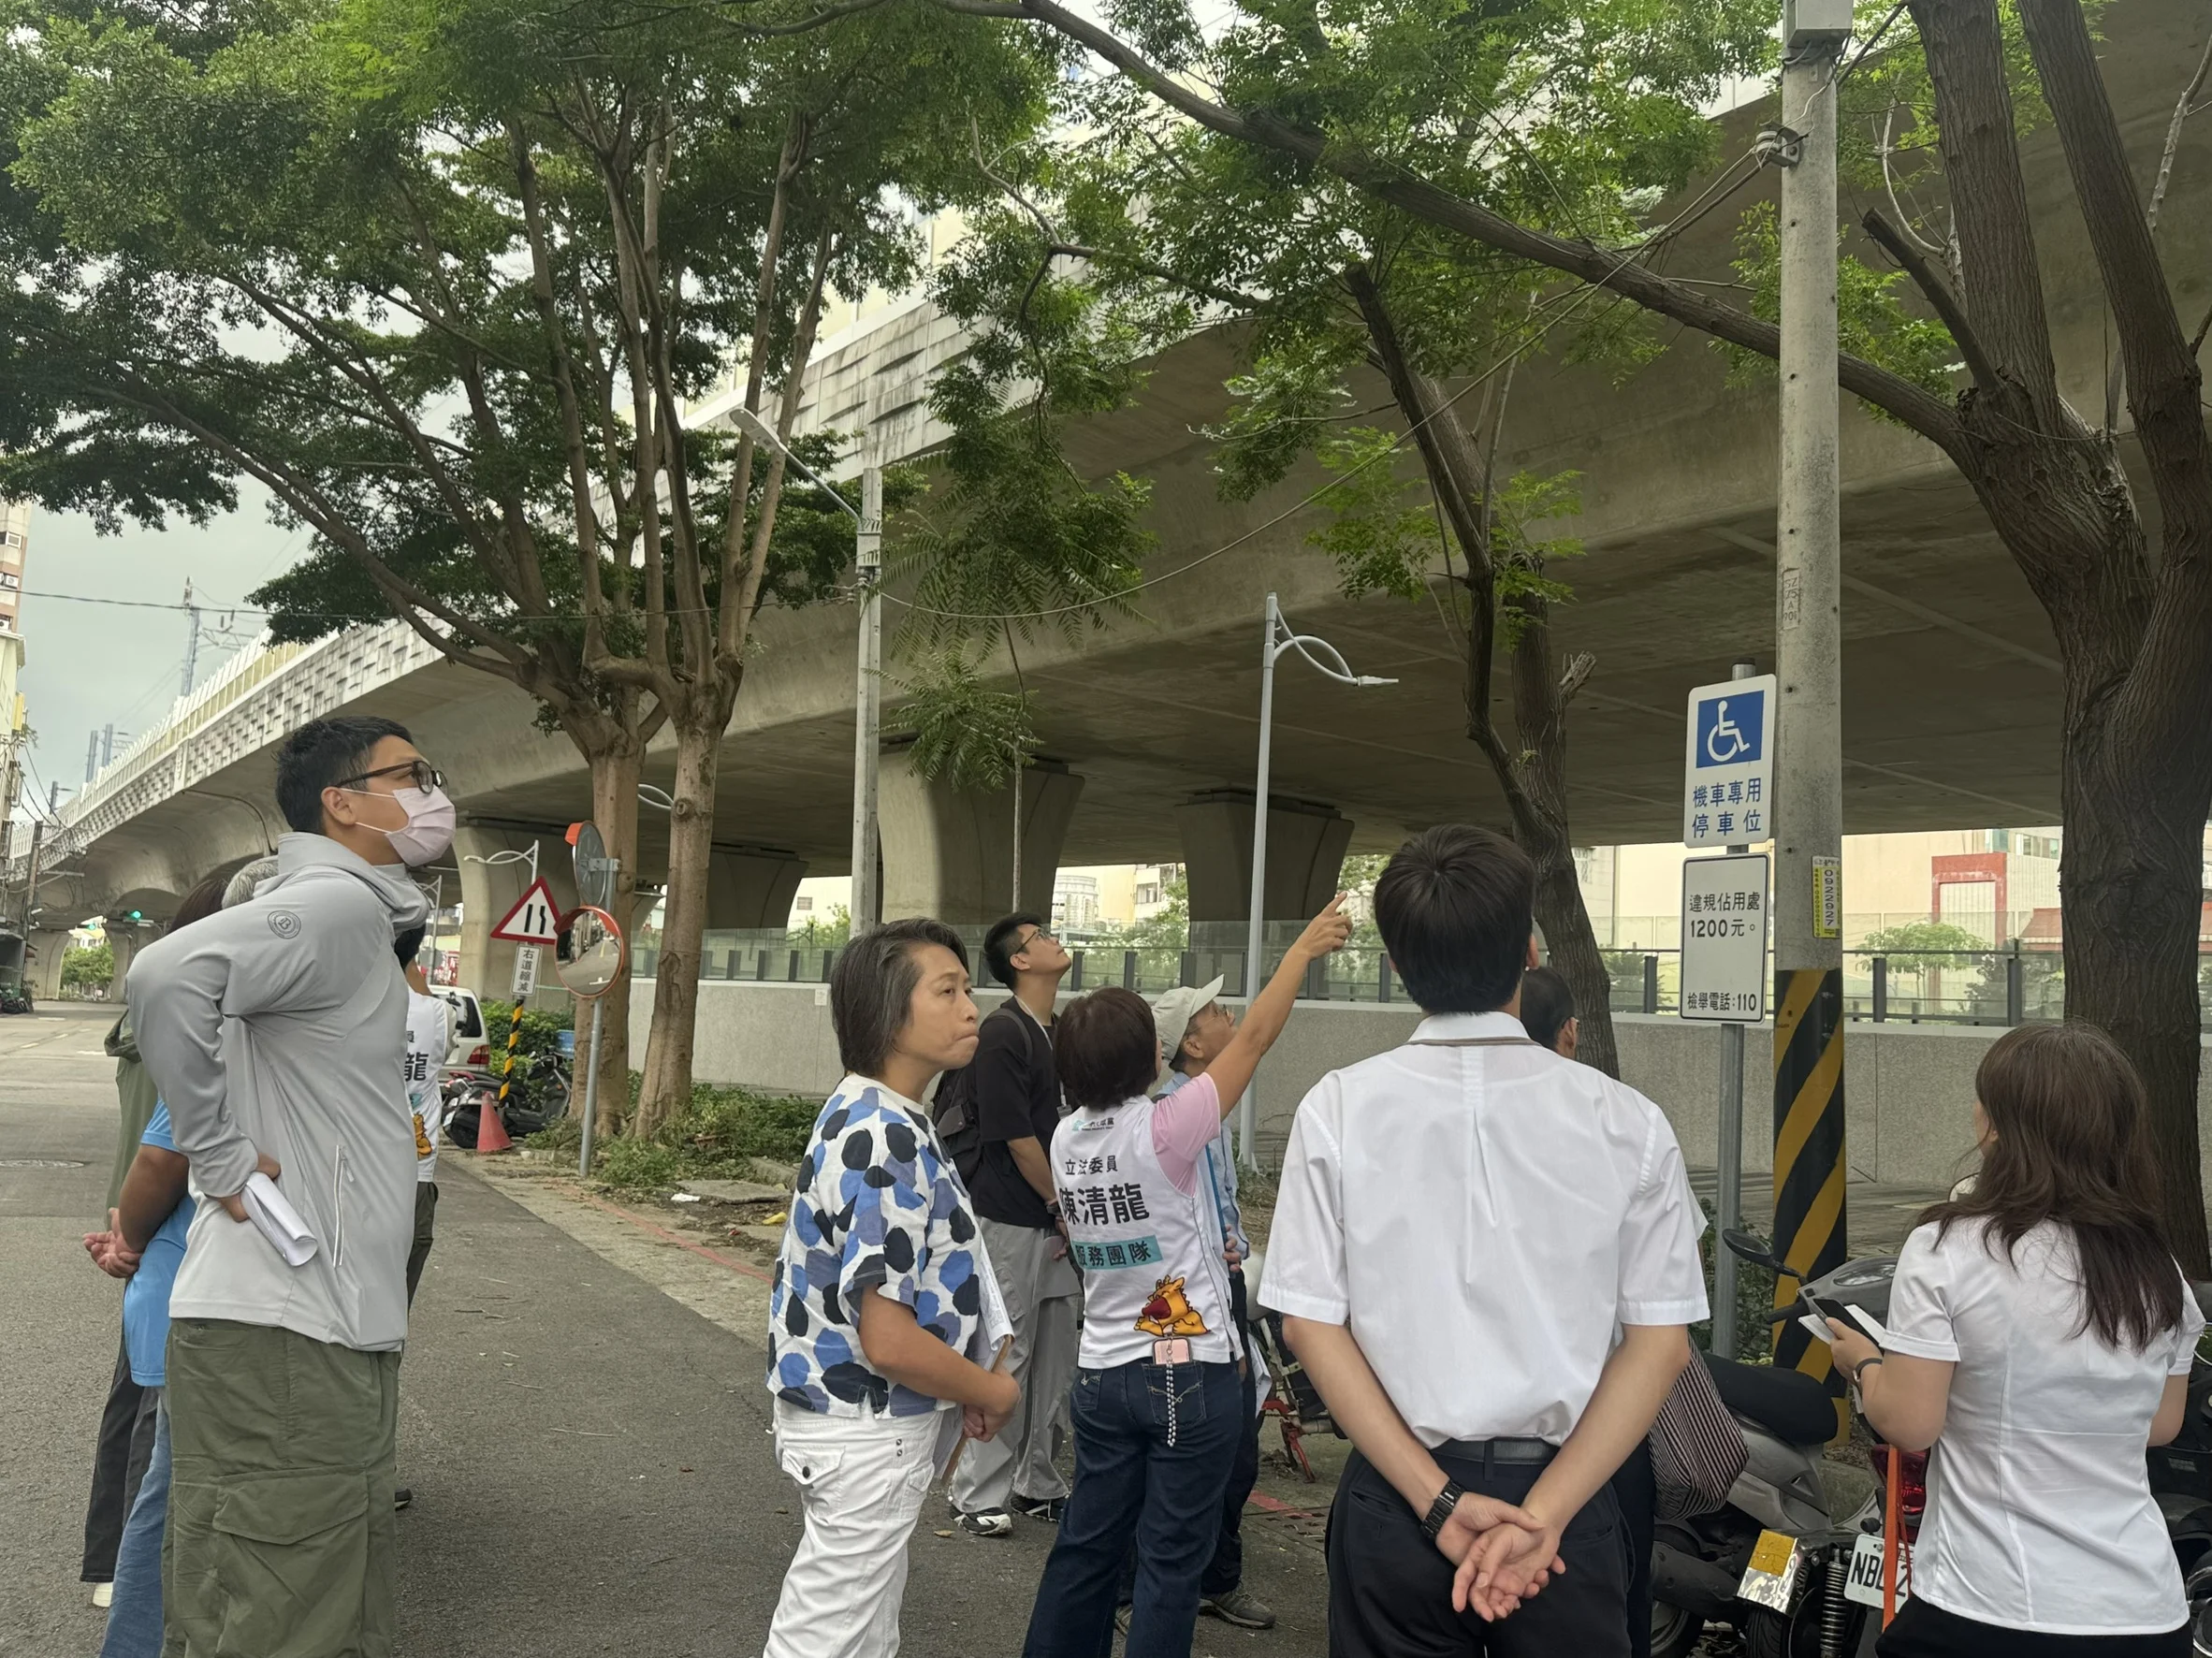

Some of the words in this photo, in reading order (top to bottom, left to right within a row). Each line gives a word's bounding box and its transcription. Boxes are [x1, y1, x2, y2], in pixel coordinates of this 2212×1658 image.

[1693, 778, 1761, 808] 機車專用
[1692, 809, 1761, 838] 停車位
[1689, 892, 1760, 912] 違規佔用處
[1824, 869, 1834, 926] 0922927
[517, 949, 534, 992] 右道縮減
[1065, 1155, 1118, 1176] 立法委員
[1059, 1183, 1150, 1226] 陳清龍
